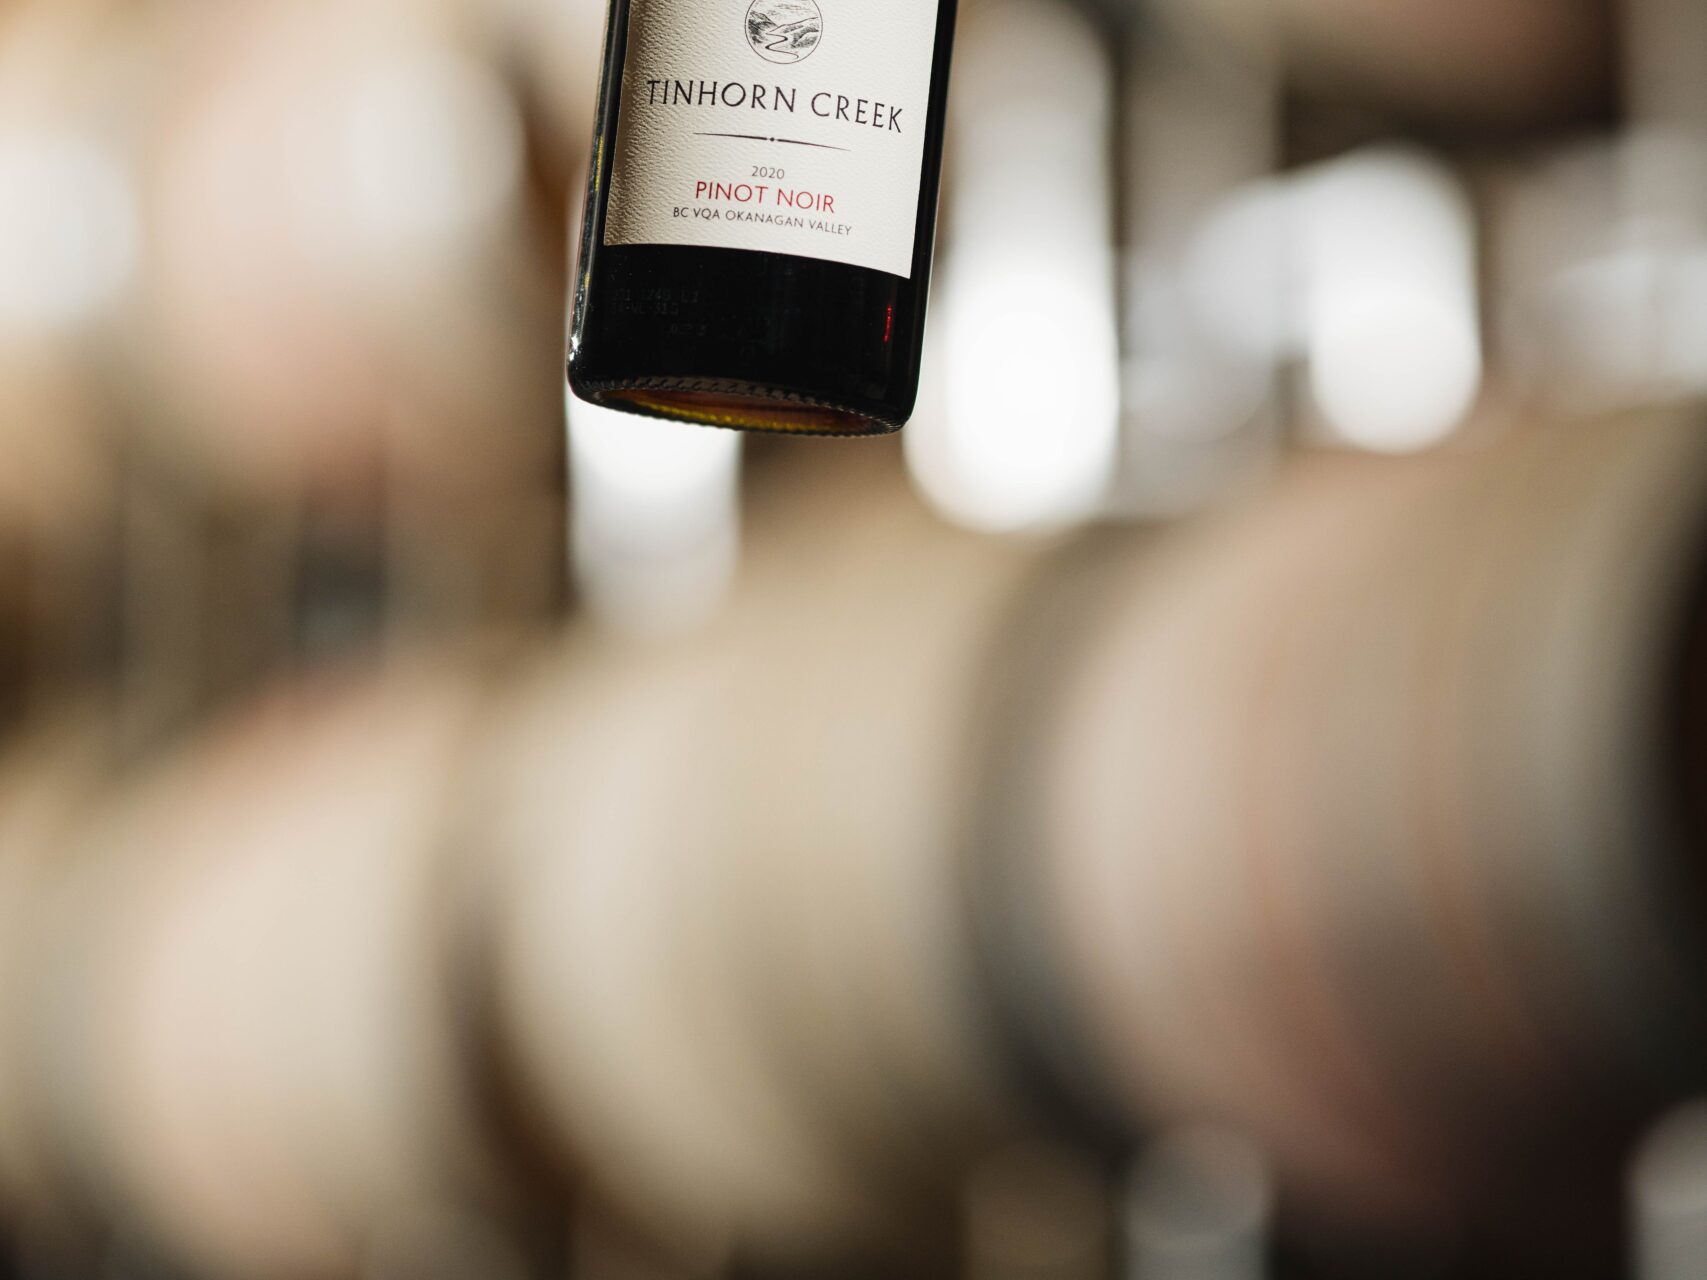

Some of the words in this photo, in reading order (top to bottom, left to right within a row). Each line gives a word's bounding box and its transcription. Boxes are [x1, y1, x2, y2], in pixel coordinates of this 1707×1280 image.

[646, 79, 797, 113] TINHORN
[810, 92, 903, 133] CREEK
[751, 165, 785, 180] 2020
[695, 180, 769, 203] PINOT
[776, 188, 835, 214] NOIR
[672, 206, 690, 218] BC
[692, 207, 721, 221] VQA
[725, 210, 804, 228] OKANAGAN
[808, 219, 852, 236] VALLEY
